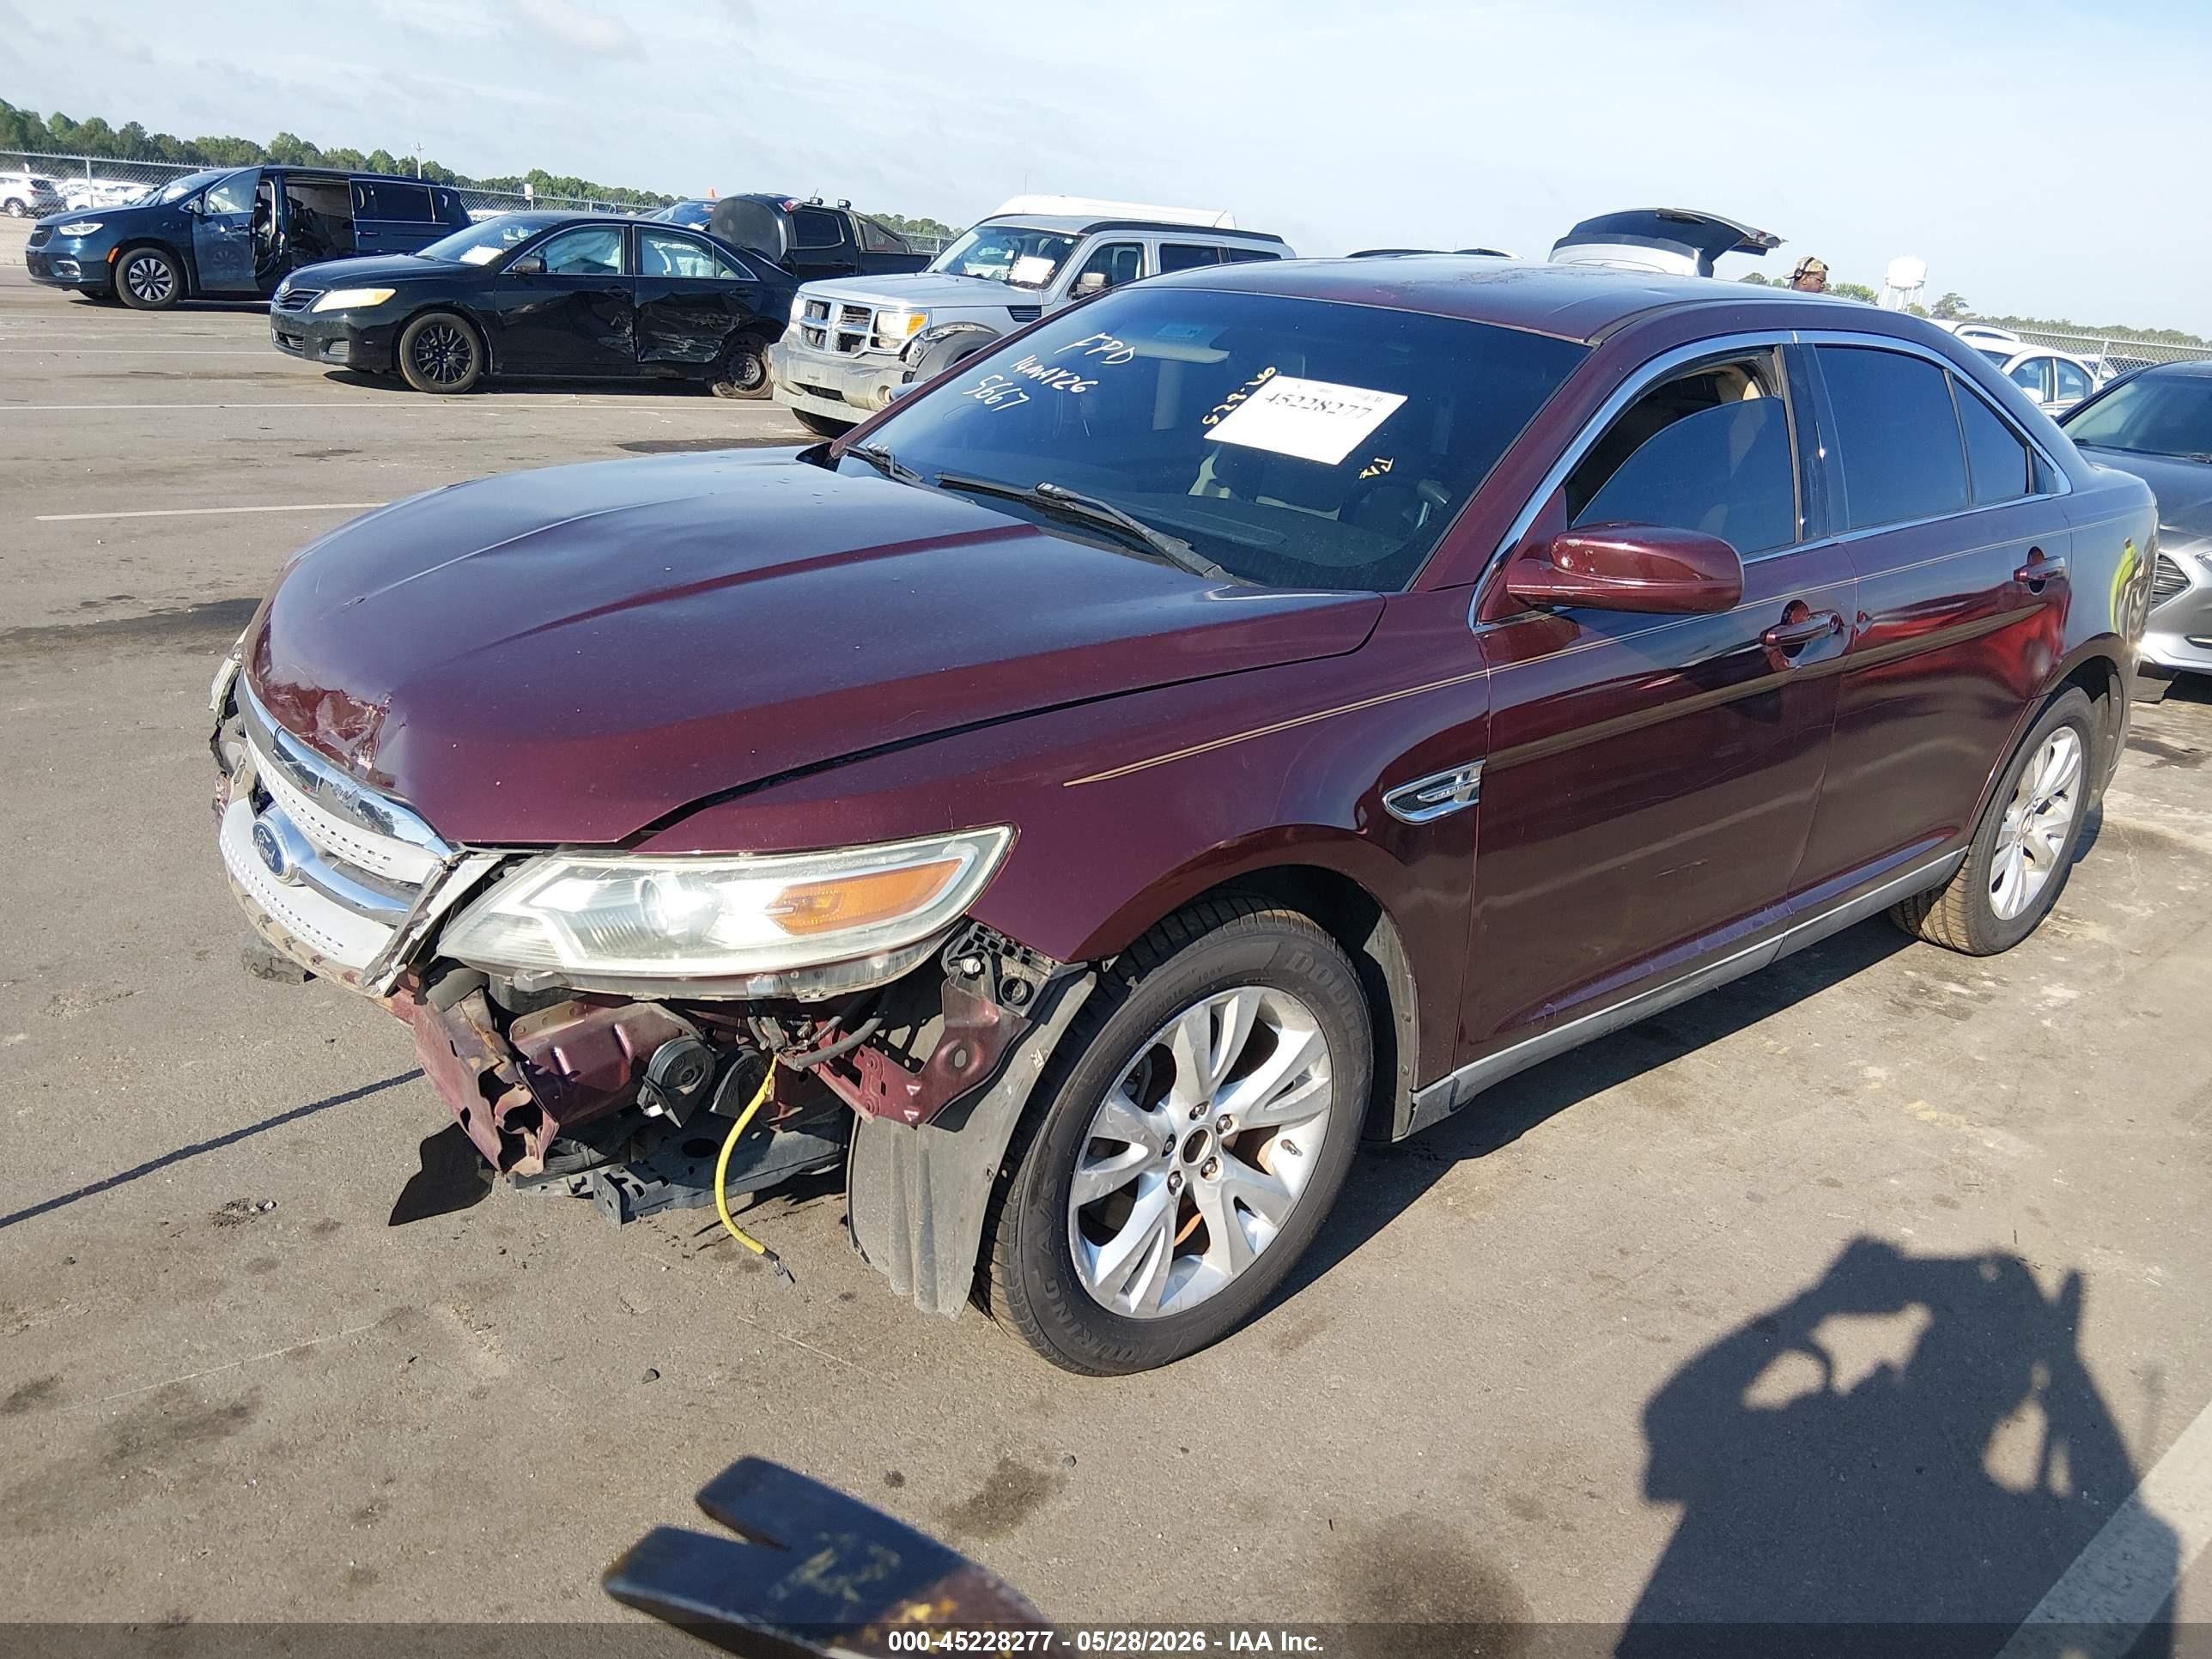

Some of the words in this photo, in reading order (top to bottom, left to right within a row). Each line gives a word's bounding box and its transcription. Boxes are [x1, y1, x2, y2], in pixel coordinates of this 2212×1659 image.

[1054, 332, 1135, 365] FPD
[962, 374, 1030, 412] 5667
[1265, 392, 1373, 420] 45228277
[255, 828, 276, 867] Ford
